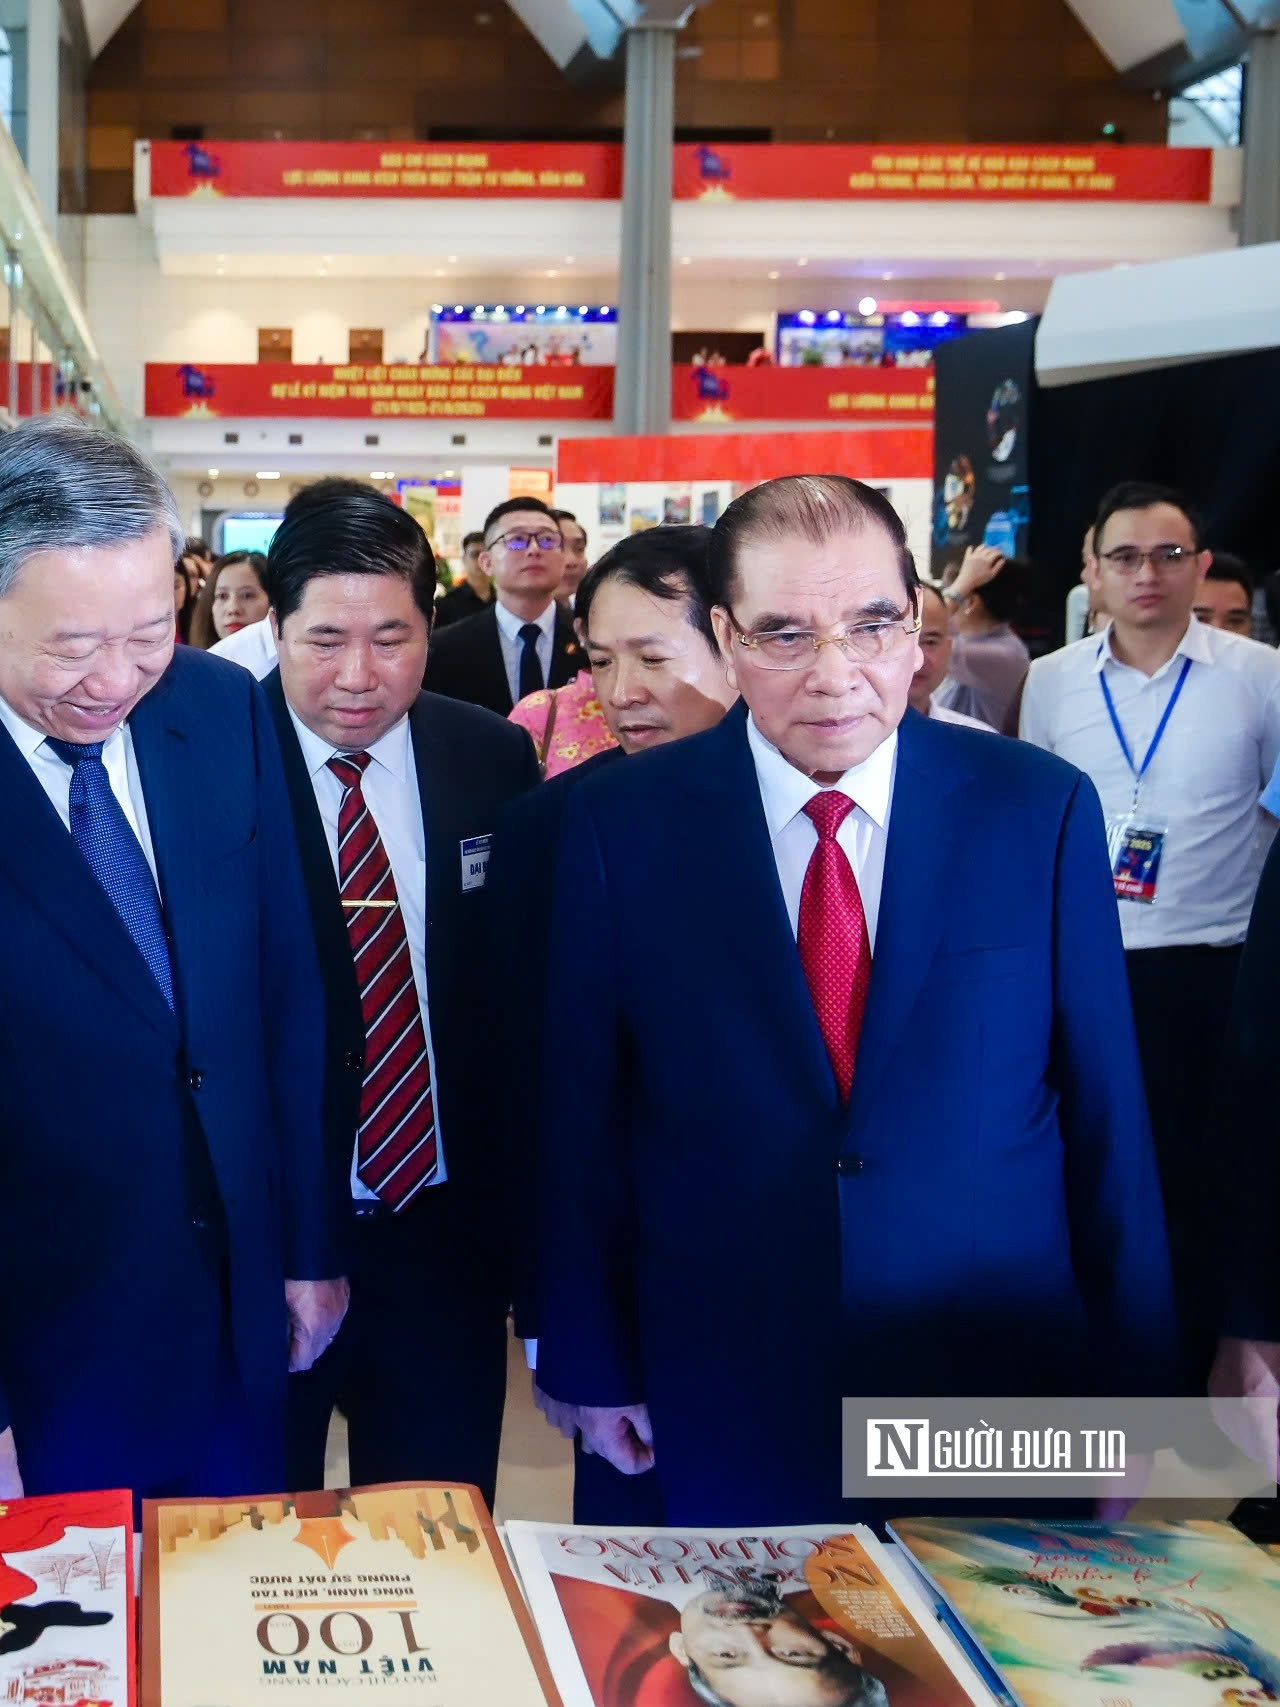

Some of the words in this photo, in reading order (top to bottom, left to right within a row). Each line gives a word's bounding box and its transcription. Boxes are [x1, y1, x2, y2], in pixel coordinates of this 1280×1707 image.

[256, 1610, 431, 1656] 100
[262, 1658, 338, 1675] NAM
[360, 1655, 434, 1675] VIỆT
